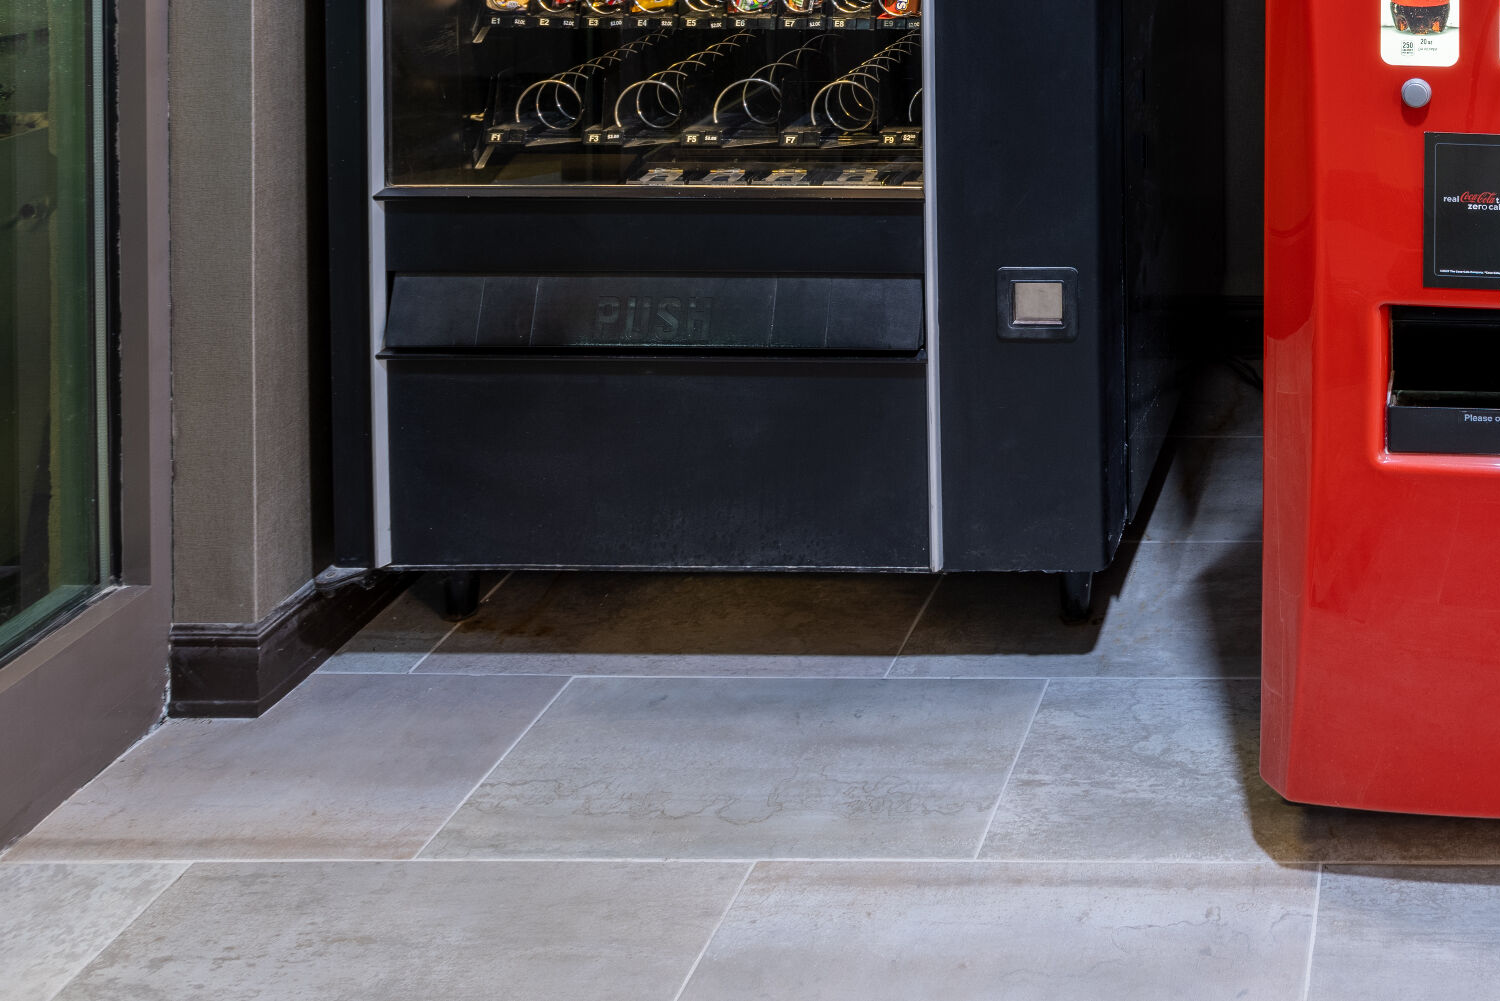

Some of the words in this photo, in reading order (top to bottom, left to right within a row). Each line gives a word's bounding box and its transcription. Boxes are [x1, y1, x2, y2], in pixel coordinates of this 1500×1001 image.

[1402, 41, 1414, 49] 250
[490, 133, 500, 141] F1
[588, 134, 599, 142] F3
[686, 135, 697, 143] F5
[785, 136, 796, 144] F7
[884, 136, 895, 144] F9
[1460, 191, 1496, 204] Coca-Cola
[598, 296, 714, 341] PUSH
[1464, 414, 1493, 423] Please
